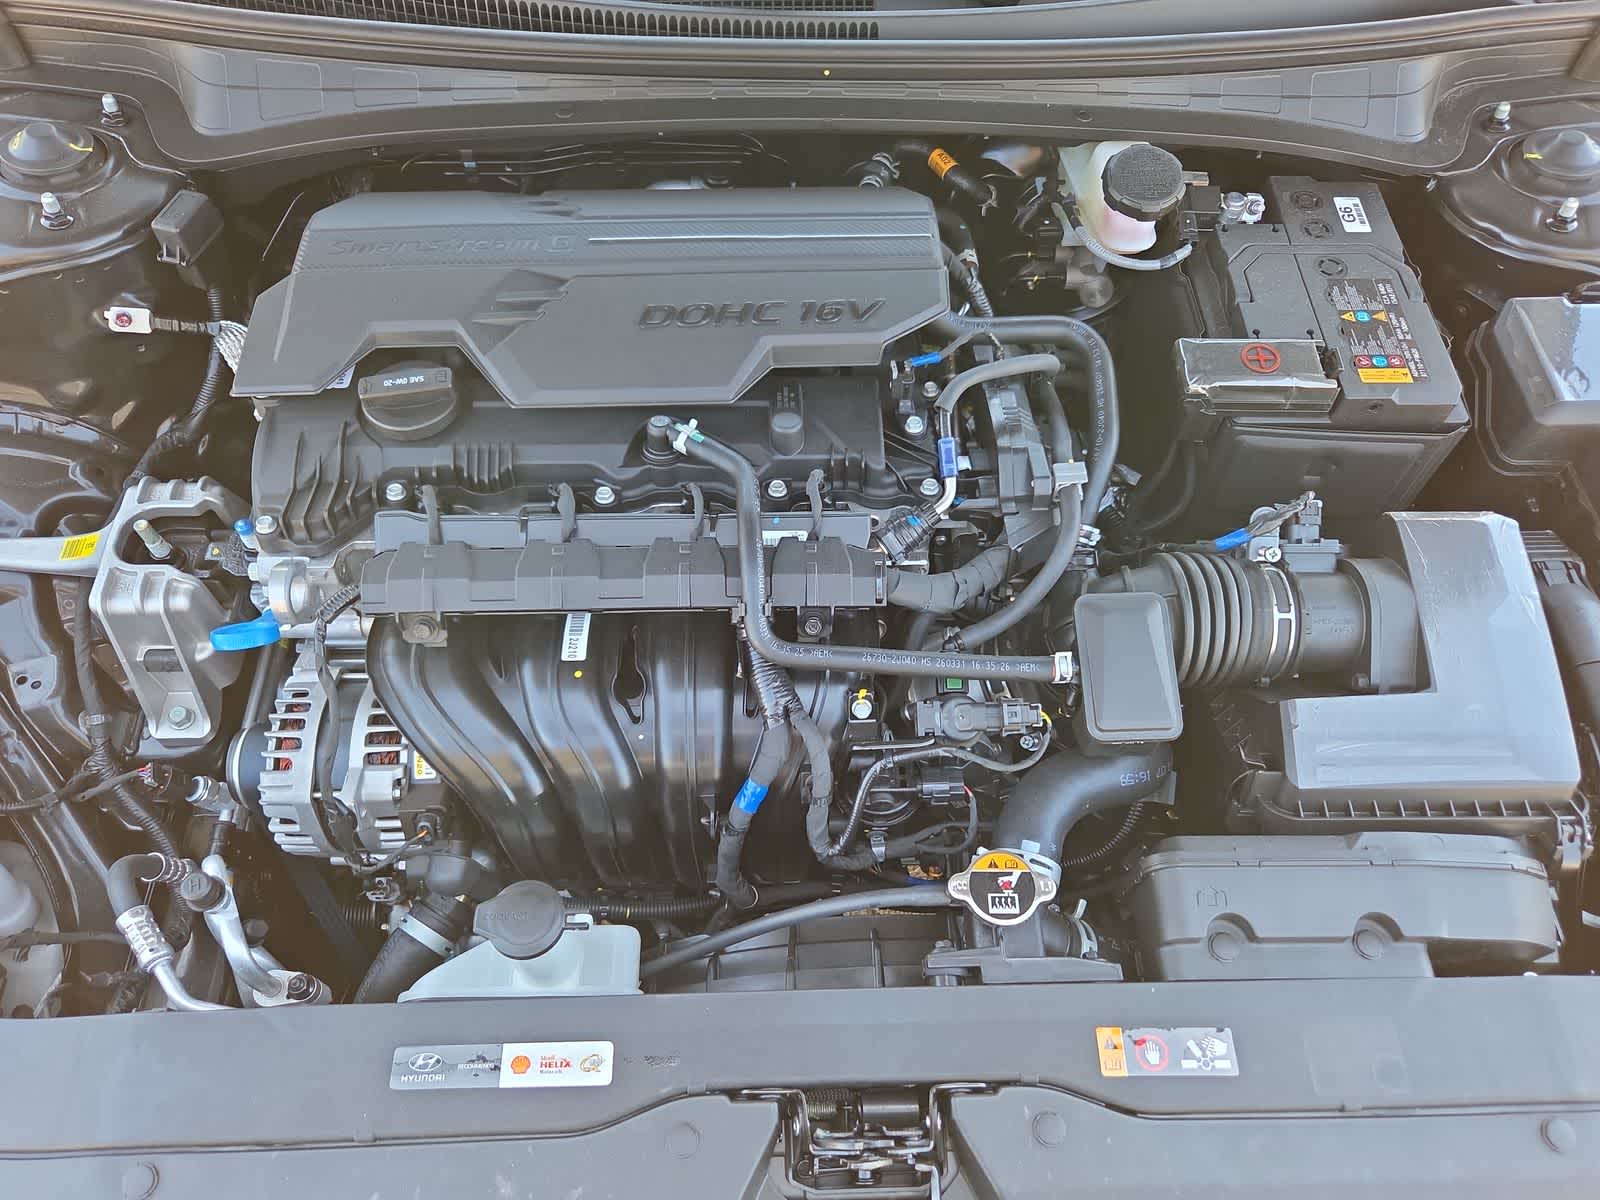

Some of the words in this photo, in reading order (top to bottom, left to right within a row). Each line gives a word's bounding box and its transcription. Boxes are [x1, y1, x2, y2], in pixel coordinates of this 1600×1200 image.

[1338, 206, 1357, 223] G6
[328, 238, 539, 256] Smartstream
[638, 300, 788, 329] DOHC
[800, 298, 887, 325] 16V
[383, 377, 408, 387] 0W-20
[409, 375, 425, 384] SAE
[862, 652, 917, 666] 26730-2J040
[921, 658, 932, 667] HS
[935, 658, 965, 669] 260331
[540, 1060, 572, 1069] HELIX
[400, 1073, 446, 1083] HYUNDAI
